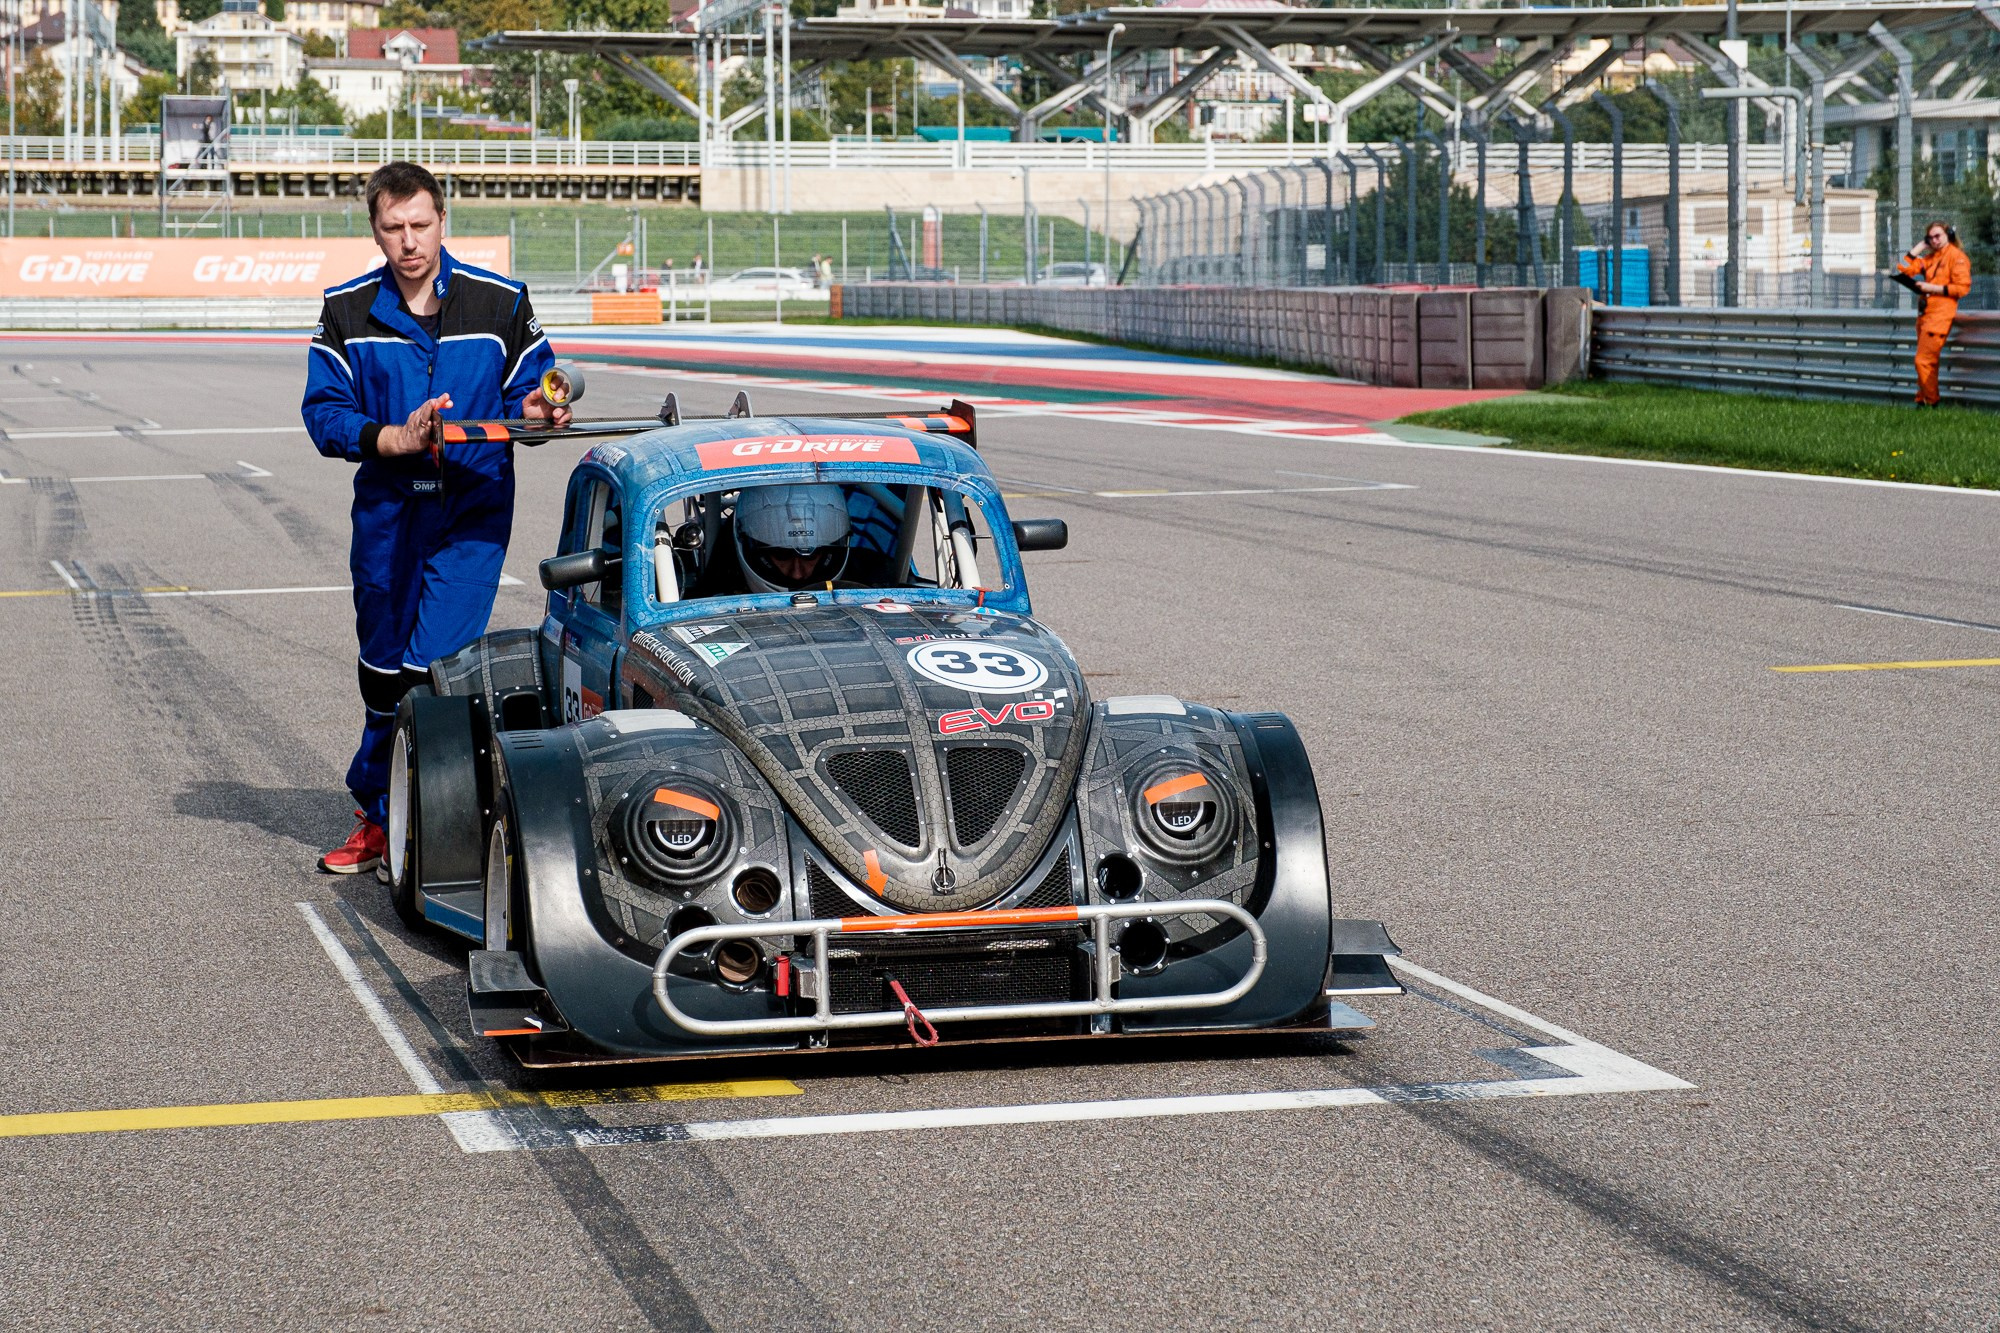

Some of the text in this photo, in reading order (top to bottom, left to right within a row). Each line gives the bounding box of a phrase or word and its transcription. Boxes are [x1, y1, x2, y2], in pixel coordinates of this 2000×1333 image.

[413, 482, 436, 491] OMP
[931, 650, 1026, 677] 33
[938, 700, 1055, 735] EVO
[1172, 815, 1192, 826] LED
[671, 834, 692, 844] LED
